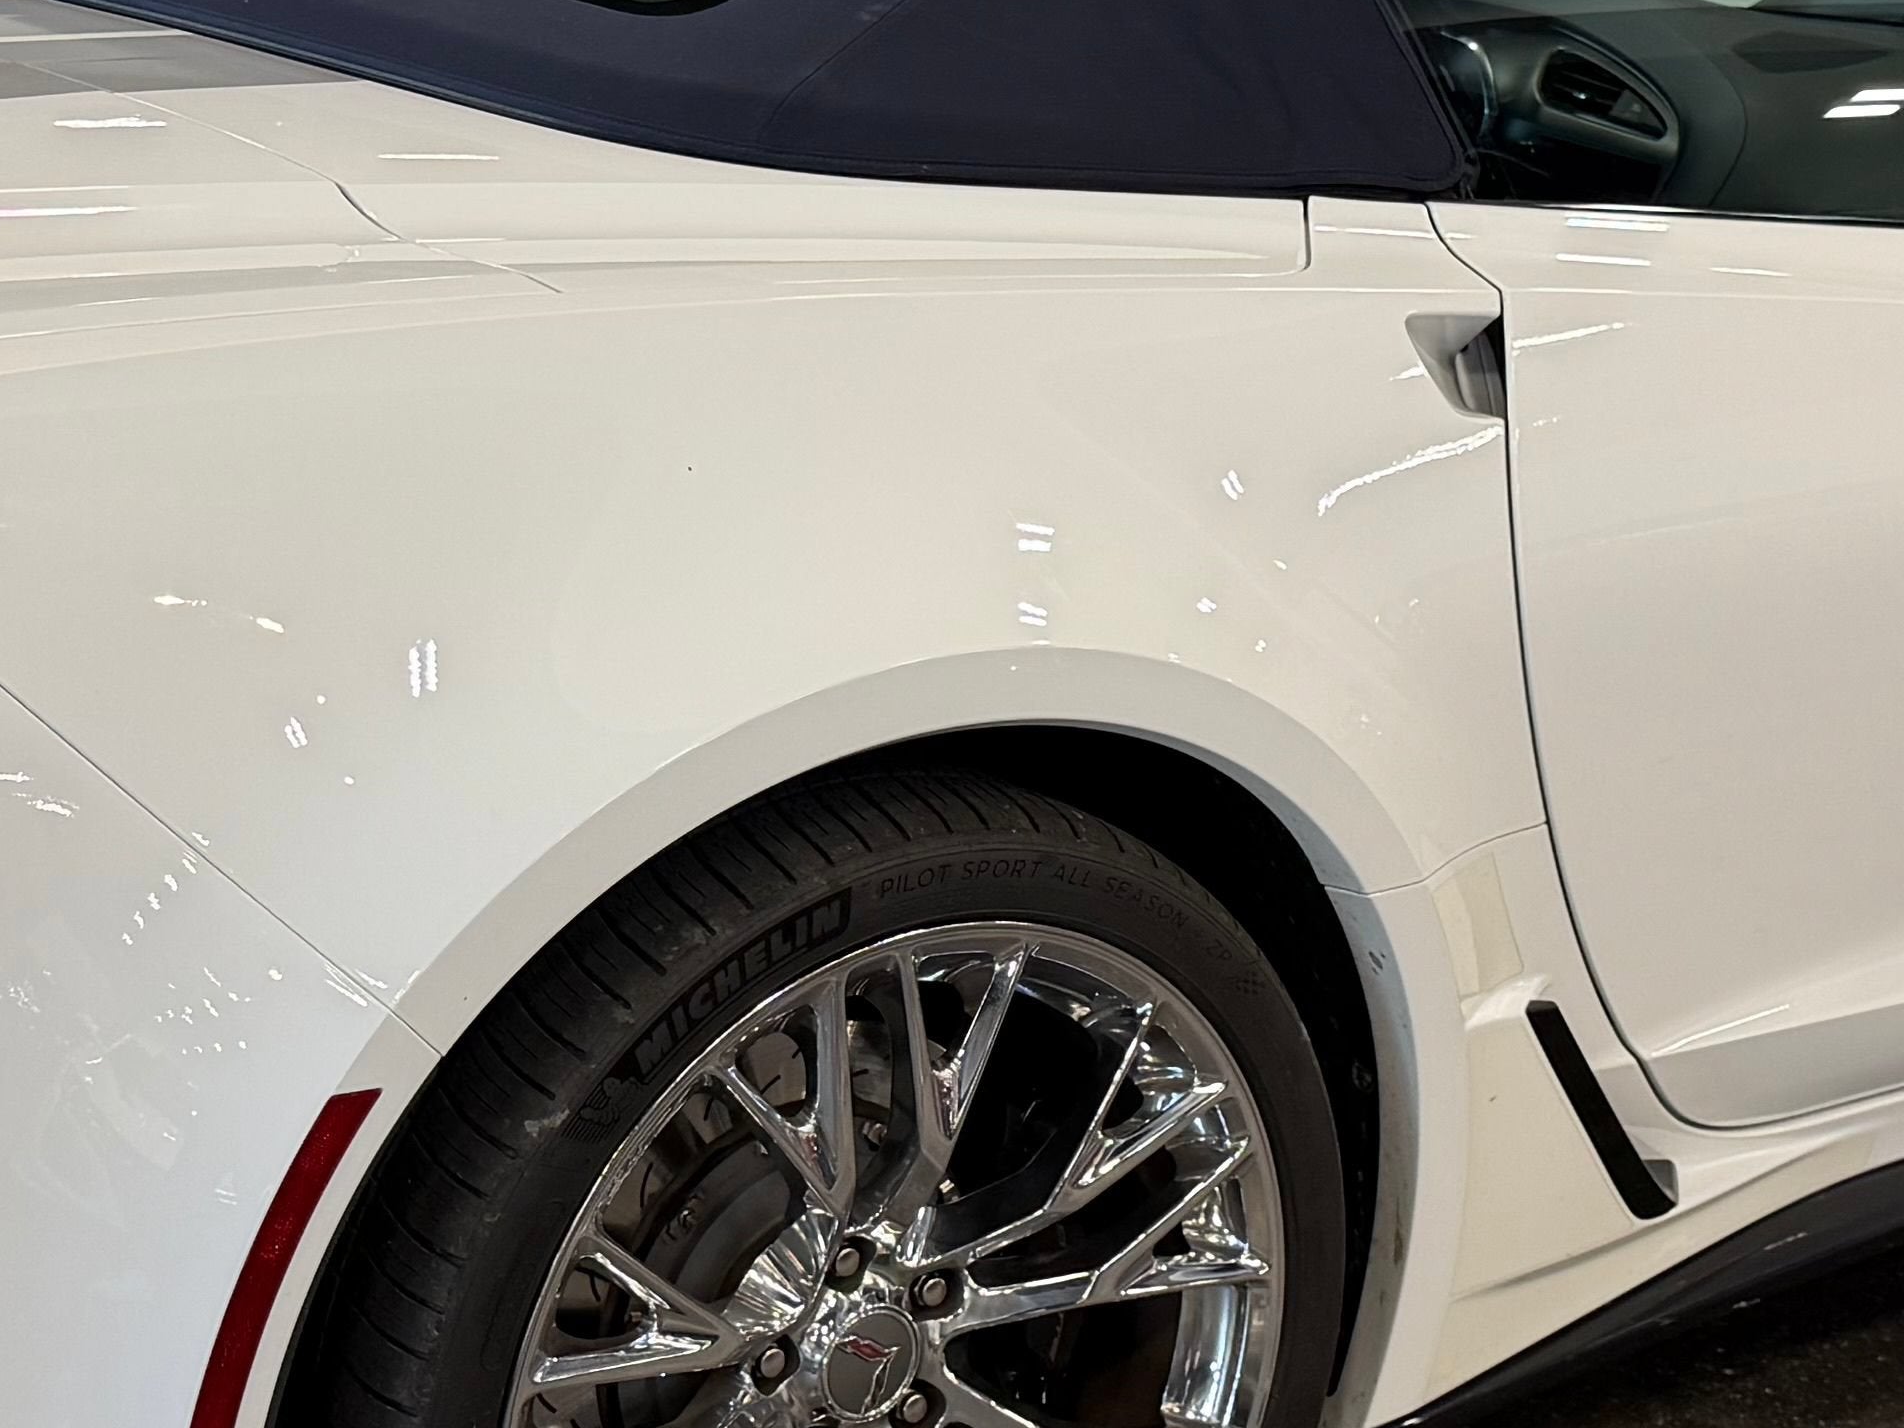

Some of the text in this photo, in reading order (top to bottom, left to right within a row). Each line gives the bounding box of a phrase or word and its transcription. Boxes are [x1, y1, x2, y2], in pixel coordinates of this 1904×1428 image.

[880, 863, 952, 899] PILOT
[960, 859, 1043, 881] SPORT
[1054, 864, 1093, 889] ALL
[1103, 876, 1188, 929] SEASON
[634, 898, 842, 1074] MICHELIN
